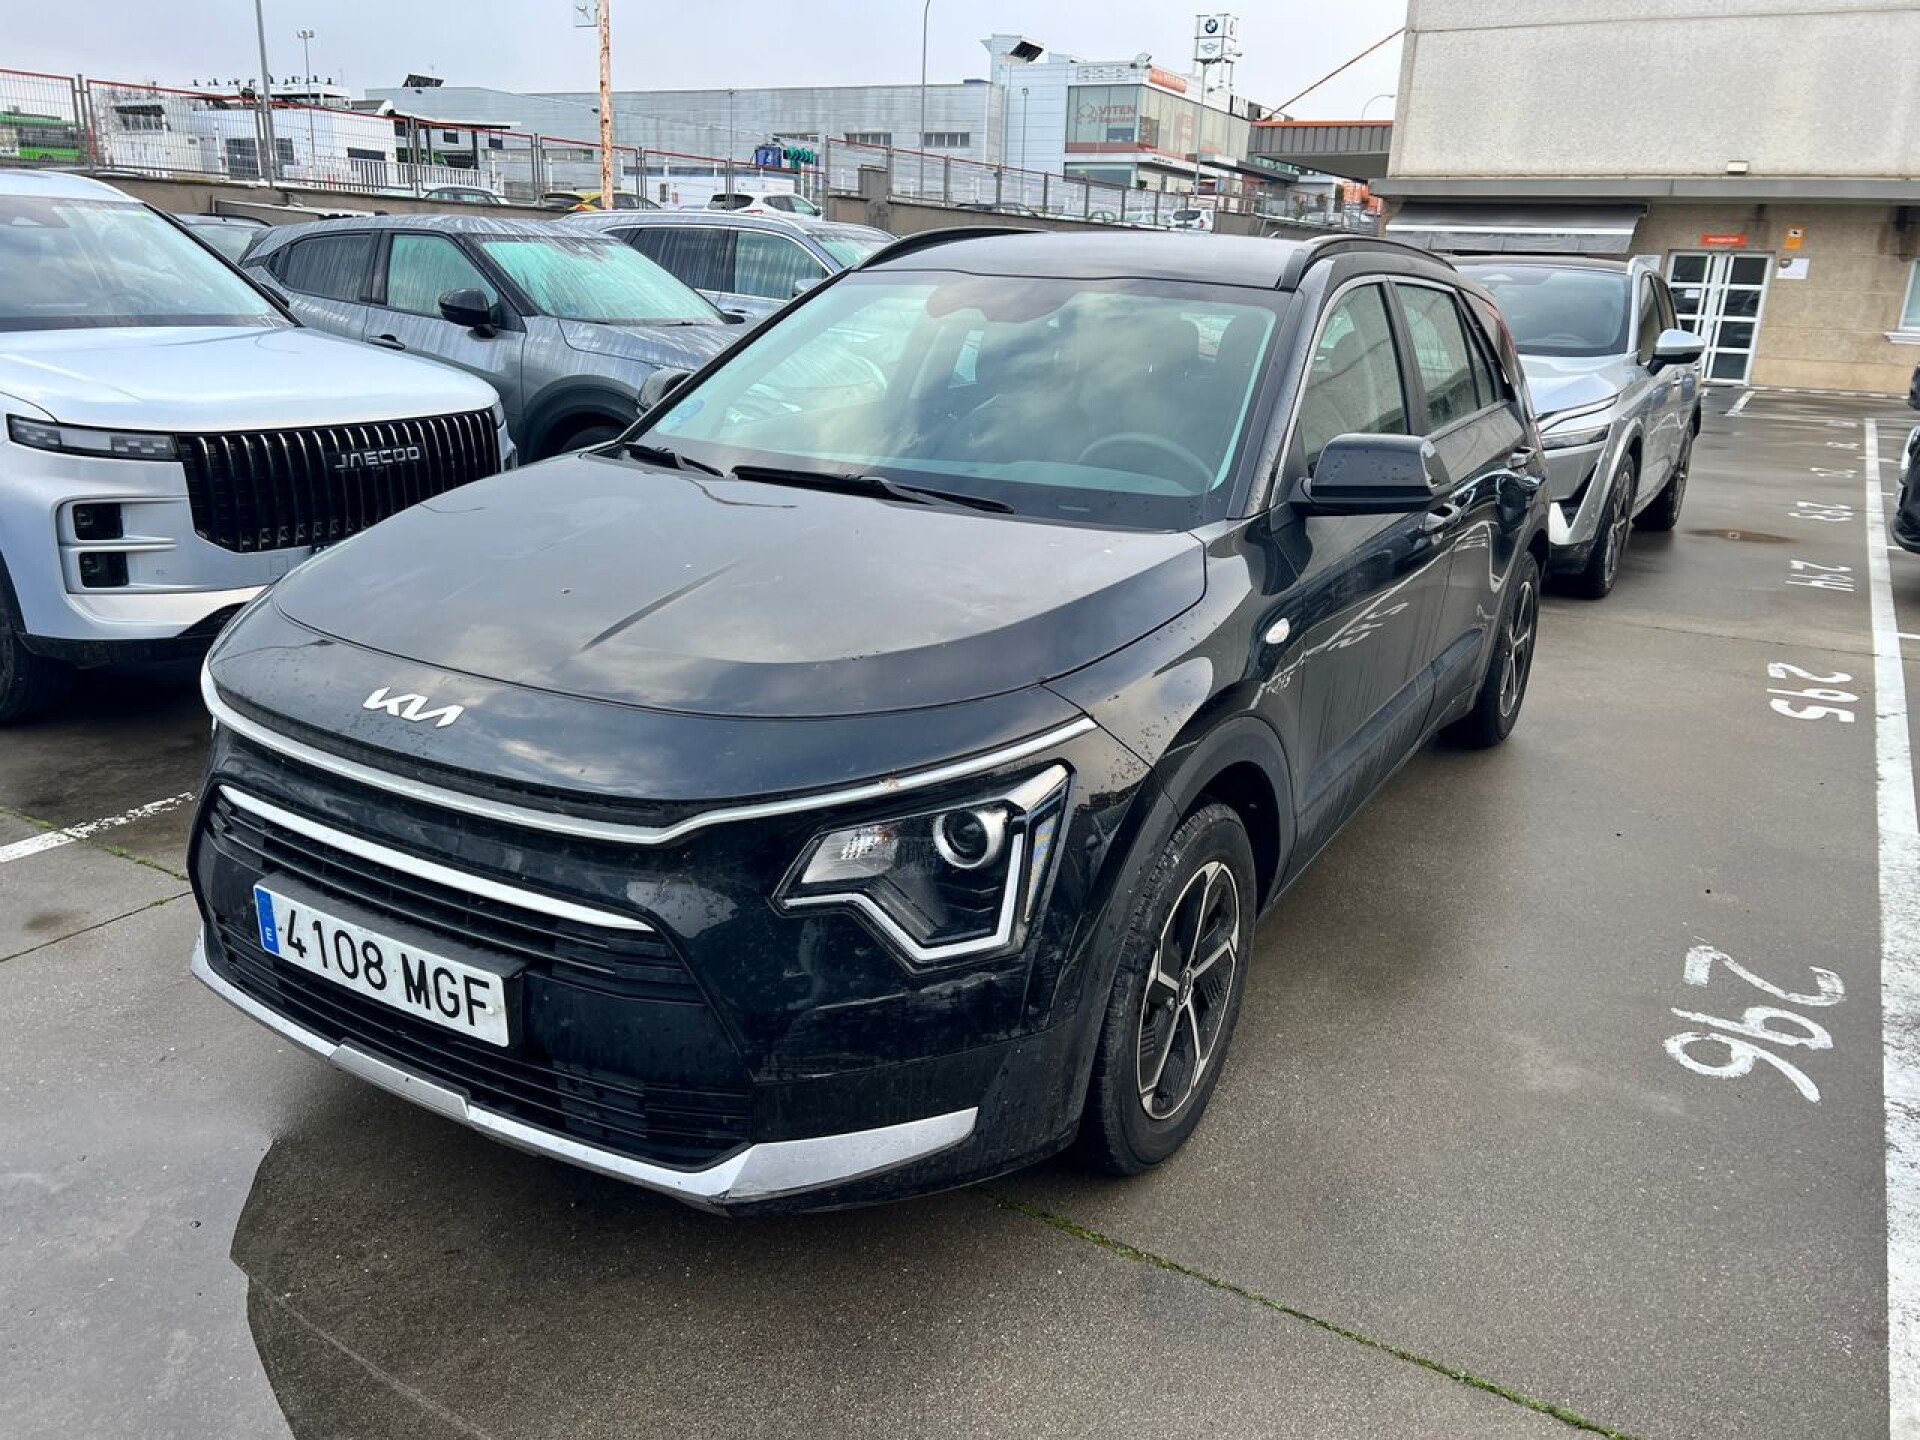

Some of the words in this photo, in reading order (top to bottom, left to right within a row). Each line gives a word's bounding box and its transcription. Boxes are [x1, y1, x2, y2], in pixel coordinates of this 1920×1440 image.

[334, 446, 420, 469] JAECOO
[1785, 560, 1855, 592] 294
[362, 686, 465, 727] KIA
[1767, 662, 1859, 722] 295
[286, 909, 388, 991] 4108
[401, 953, 490, 1027] MGF
[1662, 945, 1847, 1104] 296
